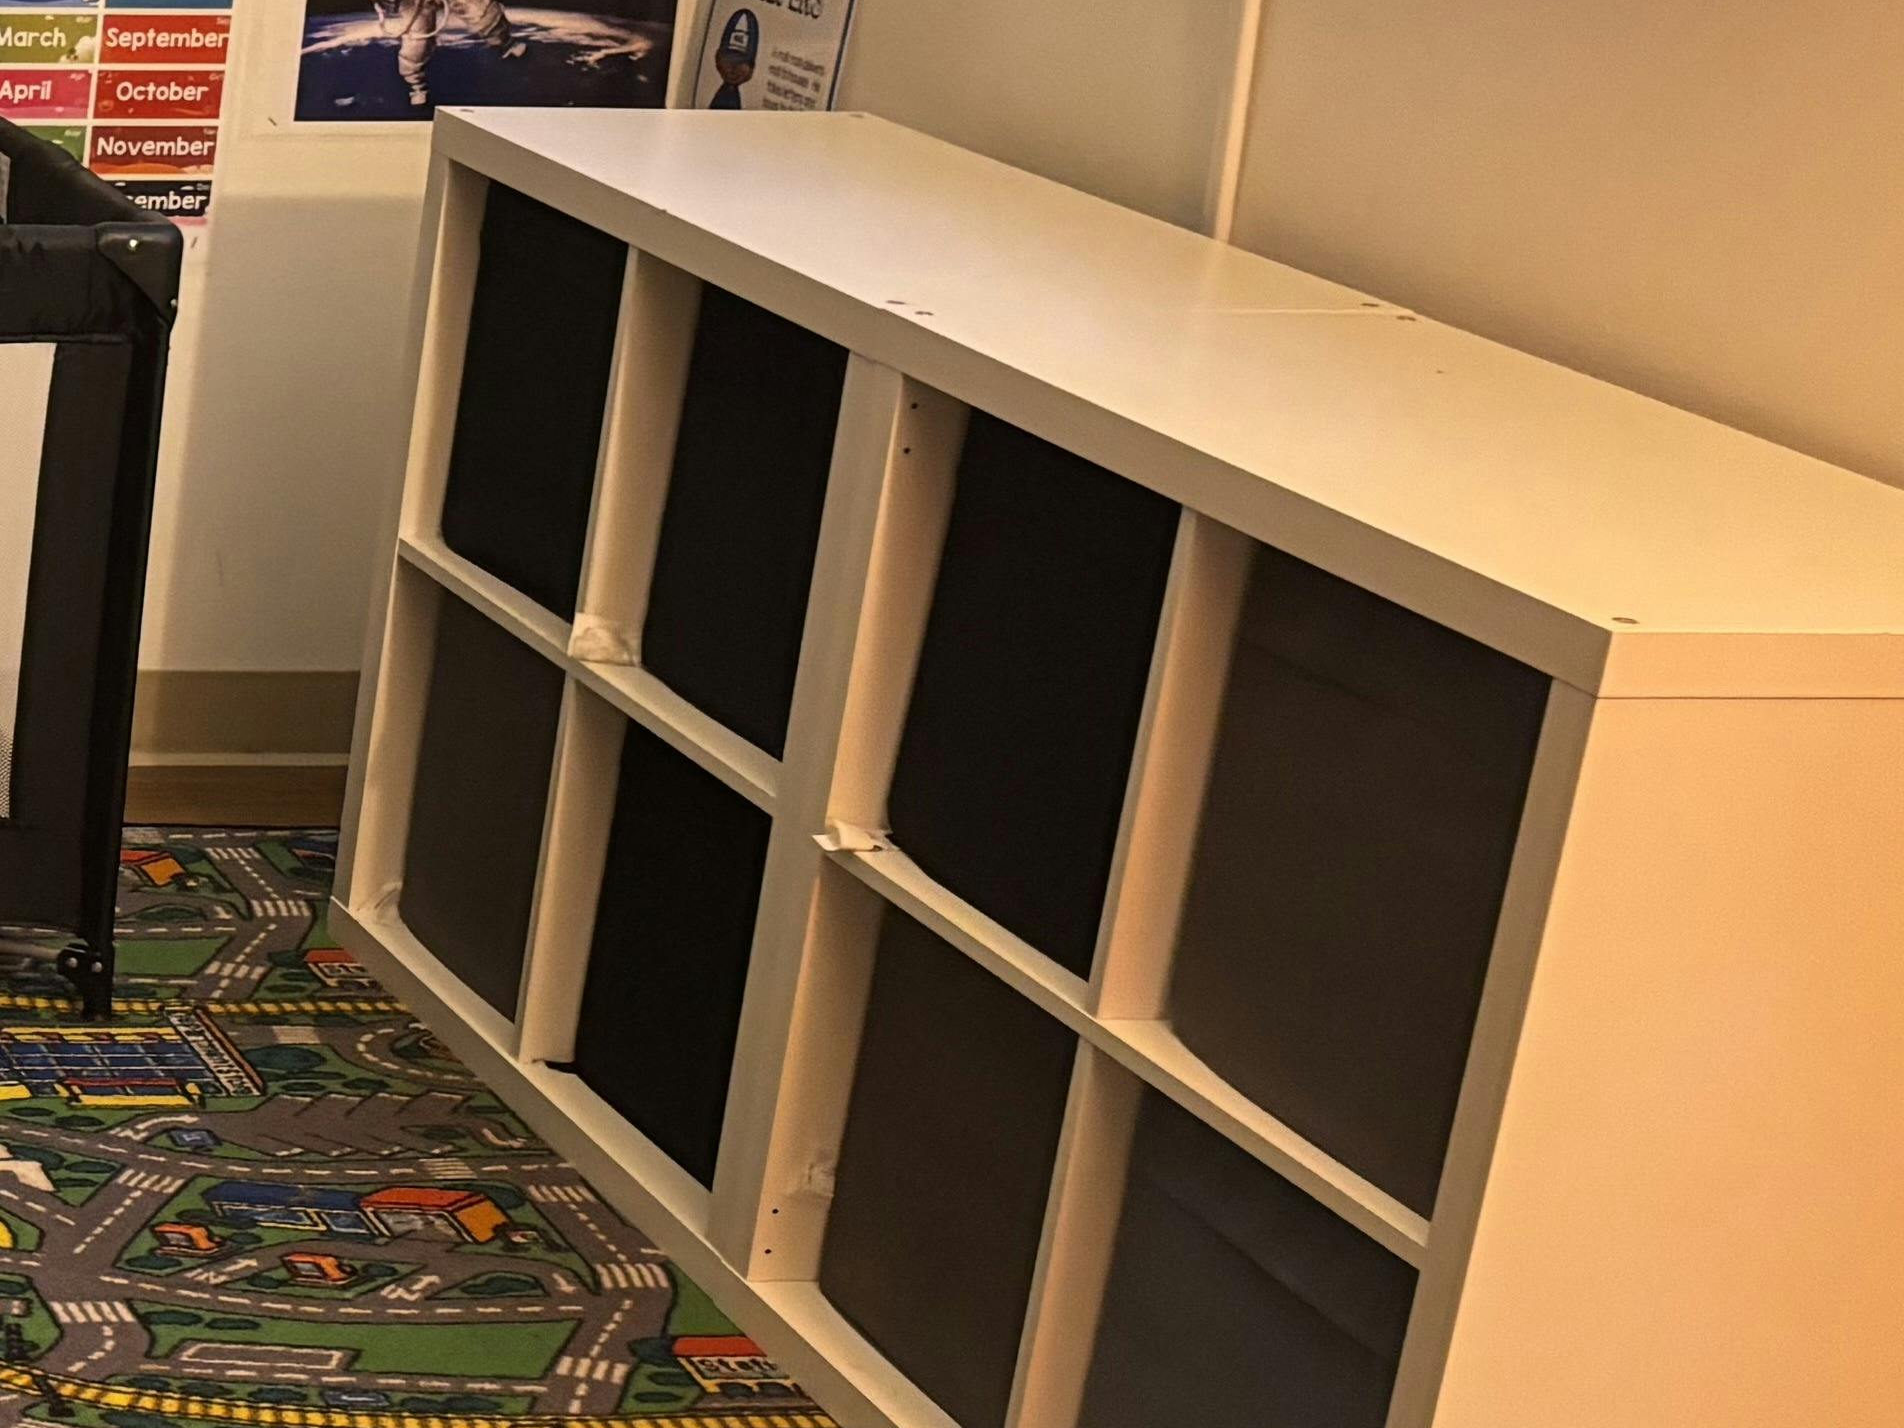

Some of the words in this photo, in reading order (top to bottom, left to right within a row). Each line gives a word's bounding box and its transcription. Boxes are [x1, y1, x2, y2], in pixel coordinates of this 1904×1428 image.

[106, 28, 230, 53] September
[116, 82, 209, 102] October
[96, 137, 215, 157] November
